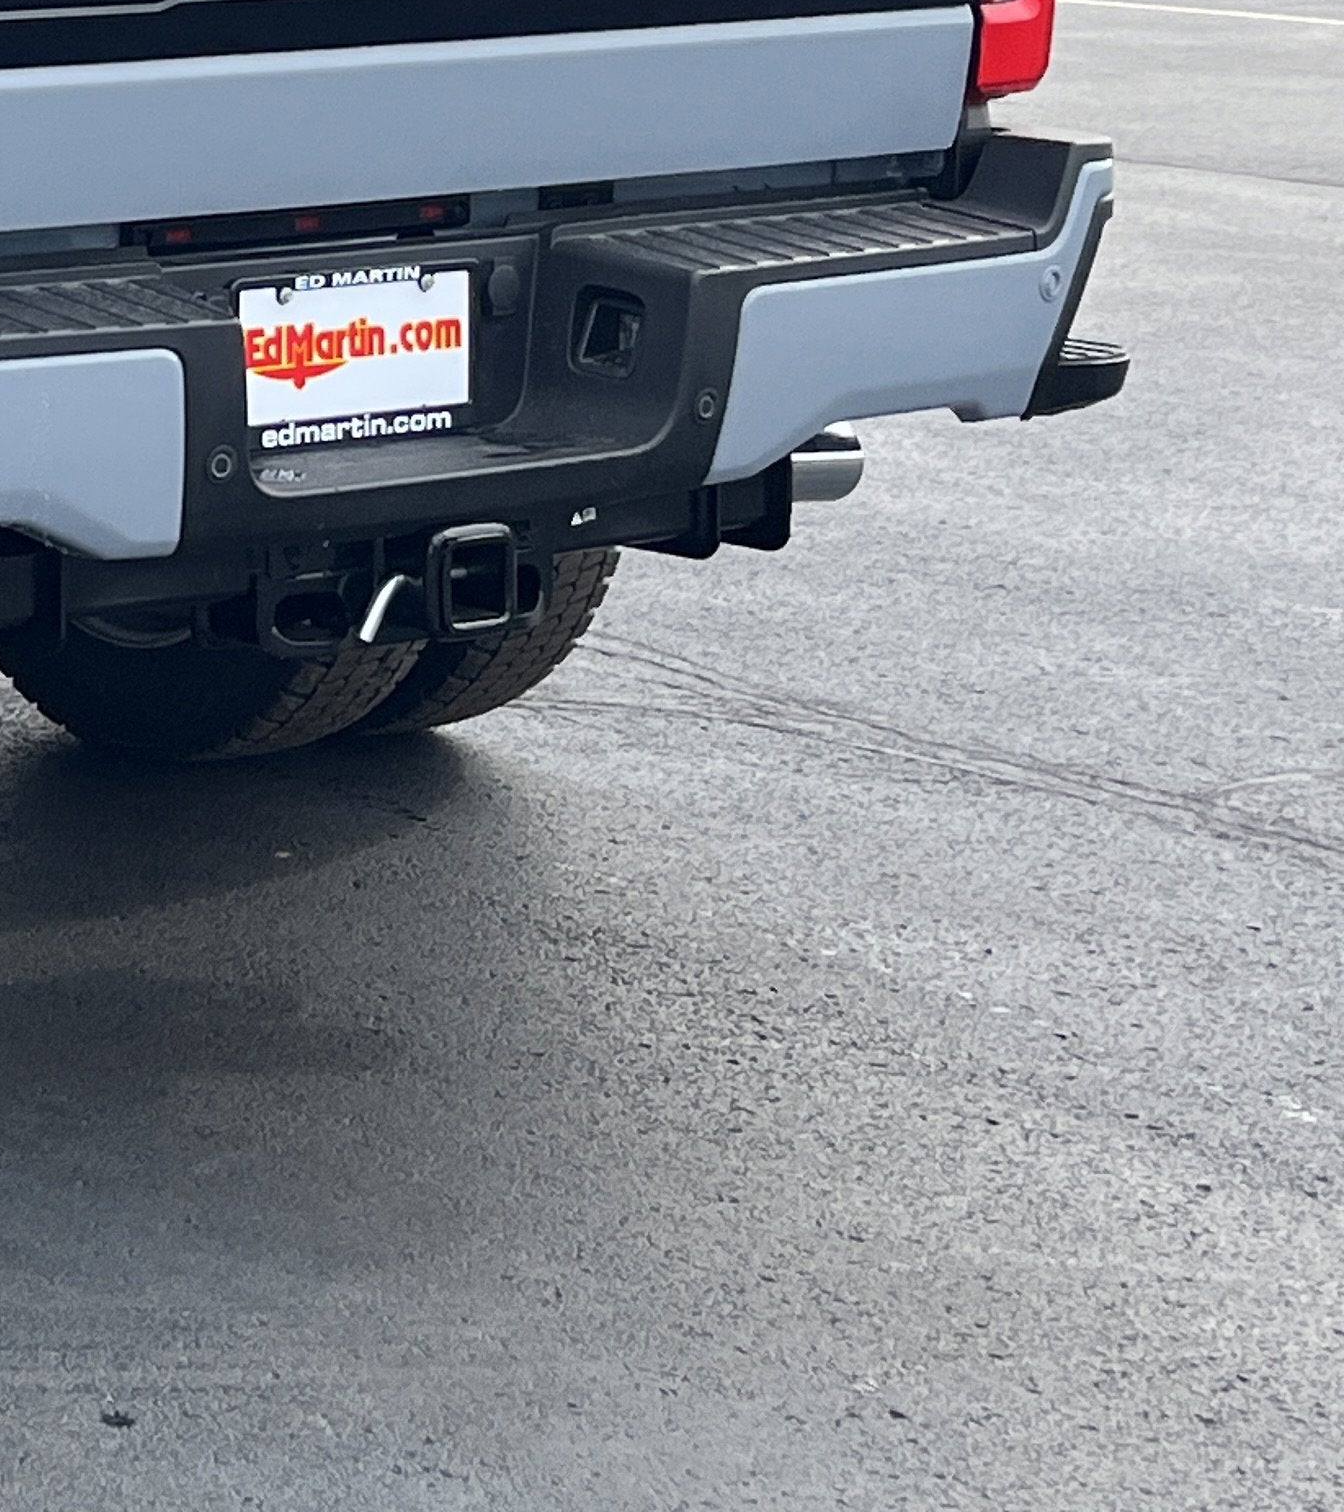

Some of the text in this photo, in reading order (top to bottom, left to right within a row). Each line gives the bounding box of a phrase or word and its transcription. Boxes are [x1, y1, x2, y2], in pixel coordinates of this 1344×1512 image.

[294, 265, 421, 290] ED MARTIN
[261, 410, 453, 449] edmartin.com
